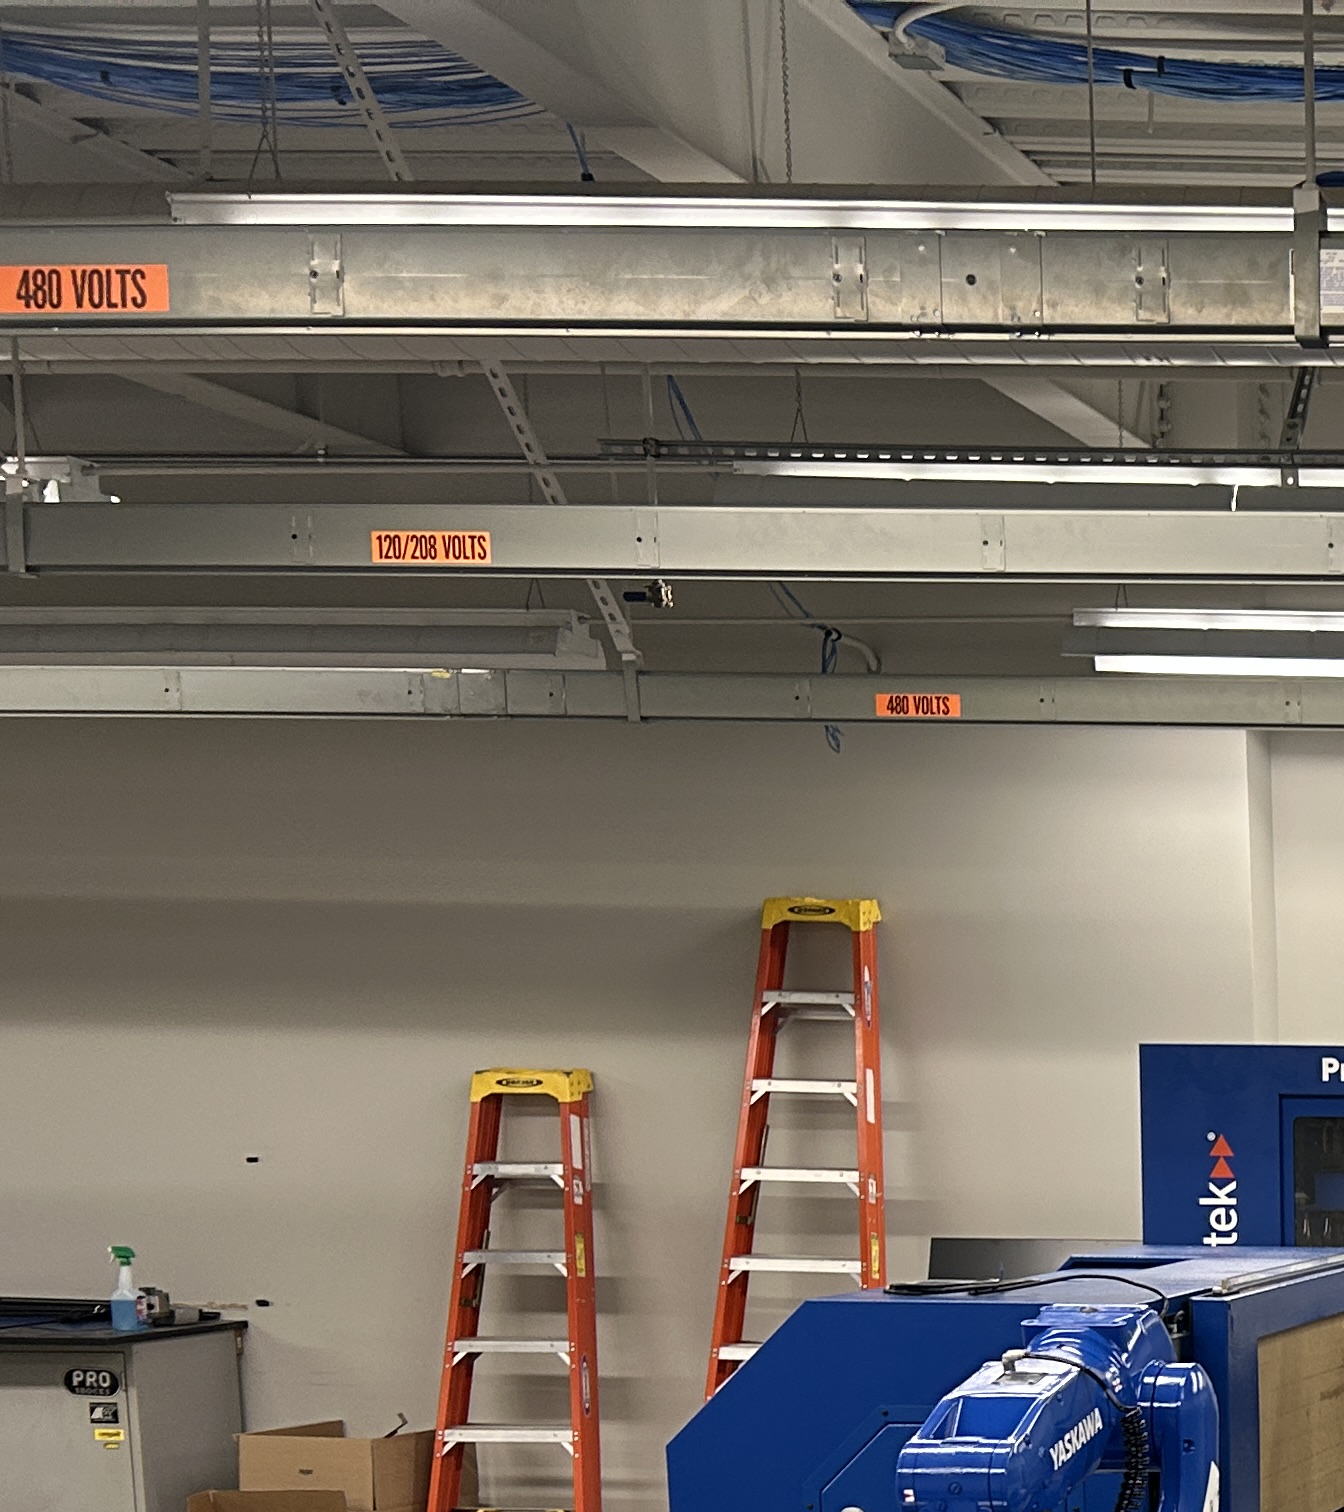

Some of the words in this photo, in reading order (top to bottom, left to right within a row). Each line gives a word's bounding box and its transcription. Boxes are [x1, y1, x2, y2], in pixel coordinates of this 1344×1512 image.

[16, 269, 62, 309] 480
[71, 269, 147, 309] VOLTS
[376, 535, 437, 561] 120/208
[442, 535, 487, 561] VOLTS
[887, 696, 909, 715] 480
[913, 696, 950, 715] VOLTS
[72, 1370, 110, 1388] PRO
[1049, 1407, 1103, 1471] YASKAWA
